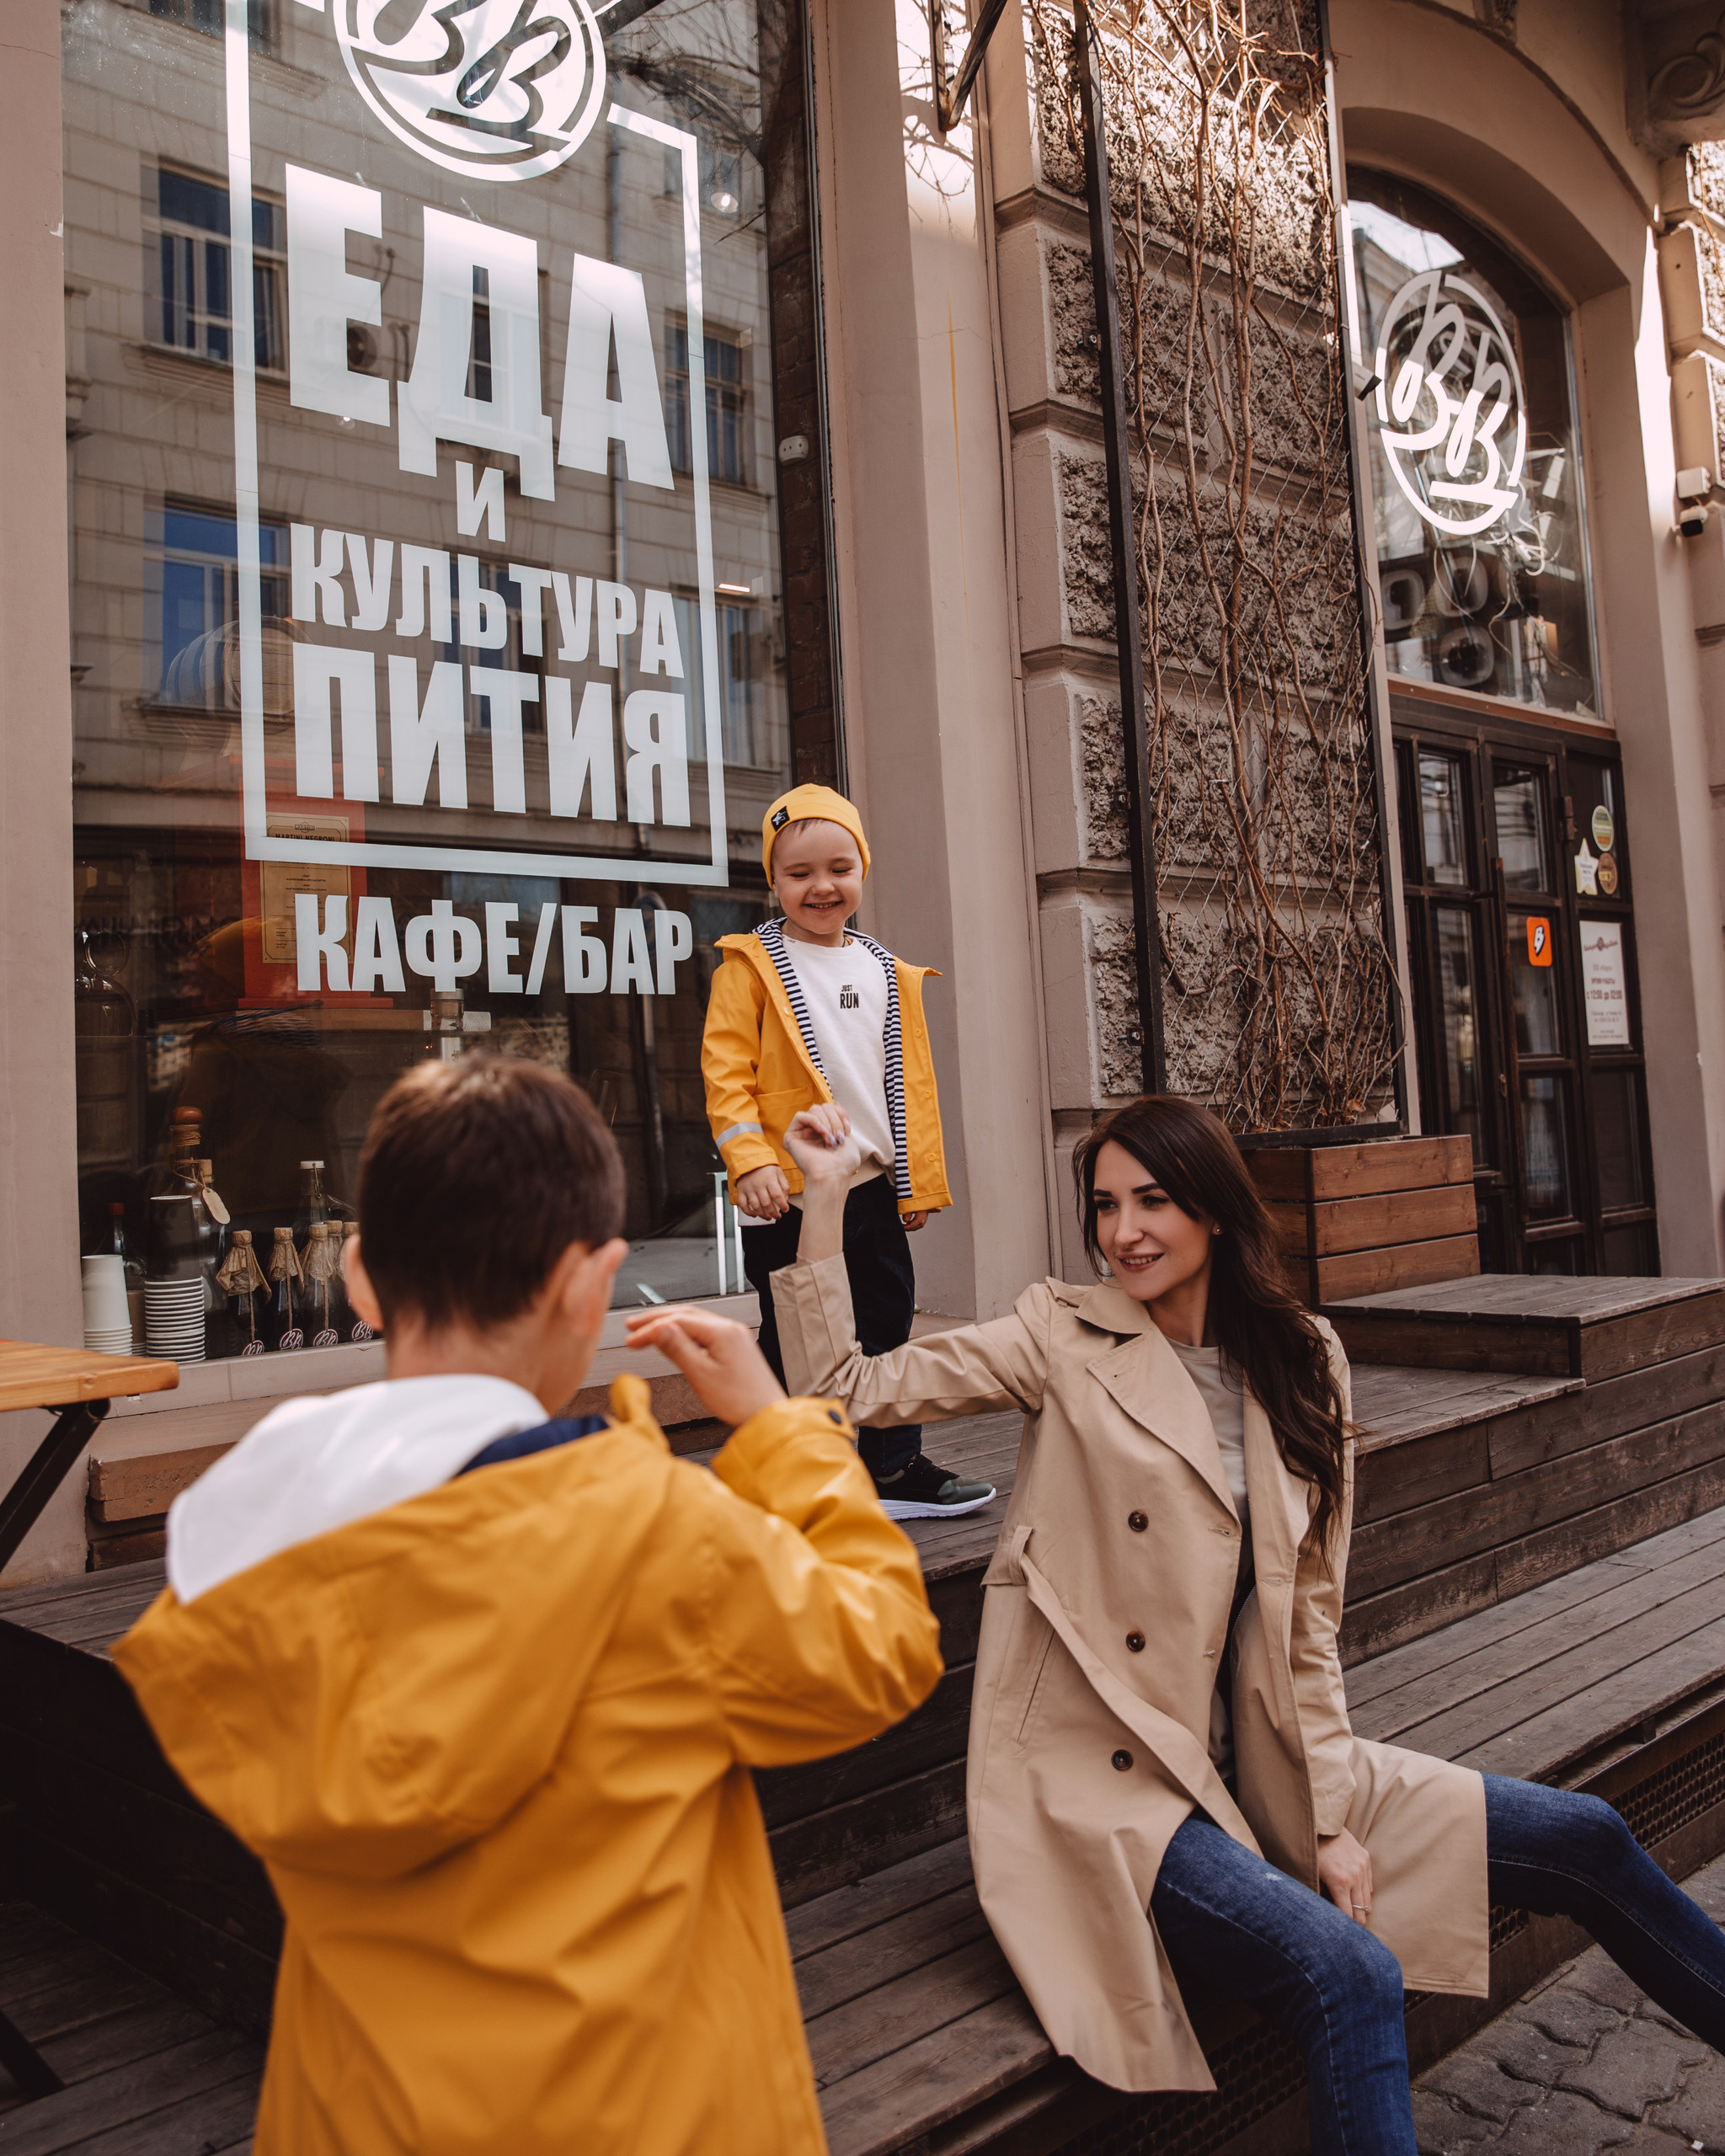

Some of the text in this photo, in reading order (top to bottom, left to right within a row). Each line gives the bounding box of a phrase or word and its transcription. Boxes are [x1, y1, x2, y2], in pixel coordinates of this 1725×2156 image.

[285, 163, 676, 502] ЕДА
[455, 460, 506, 542] И
[290, 522, 685, 679] КУЛЬТУРА
[292, 642, 692, 827] ПИТИЯ
[295, 894, 693, 995] КАФЕ/БАР
[840, 992, 859, 1009] RUN
